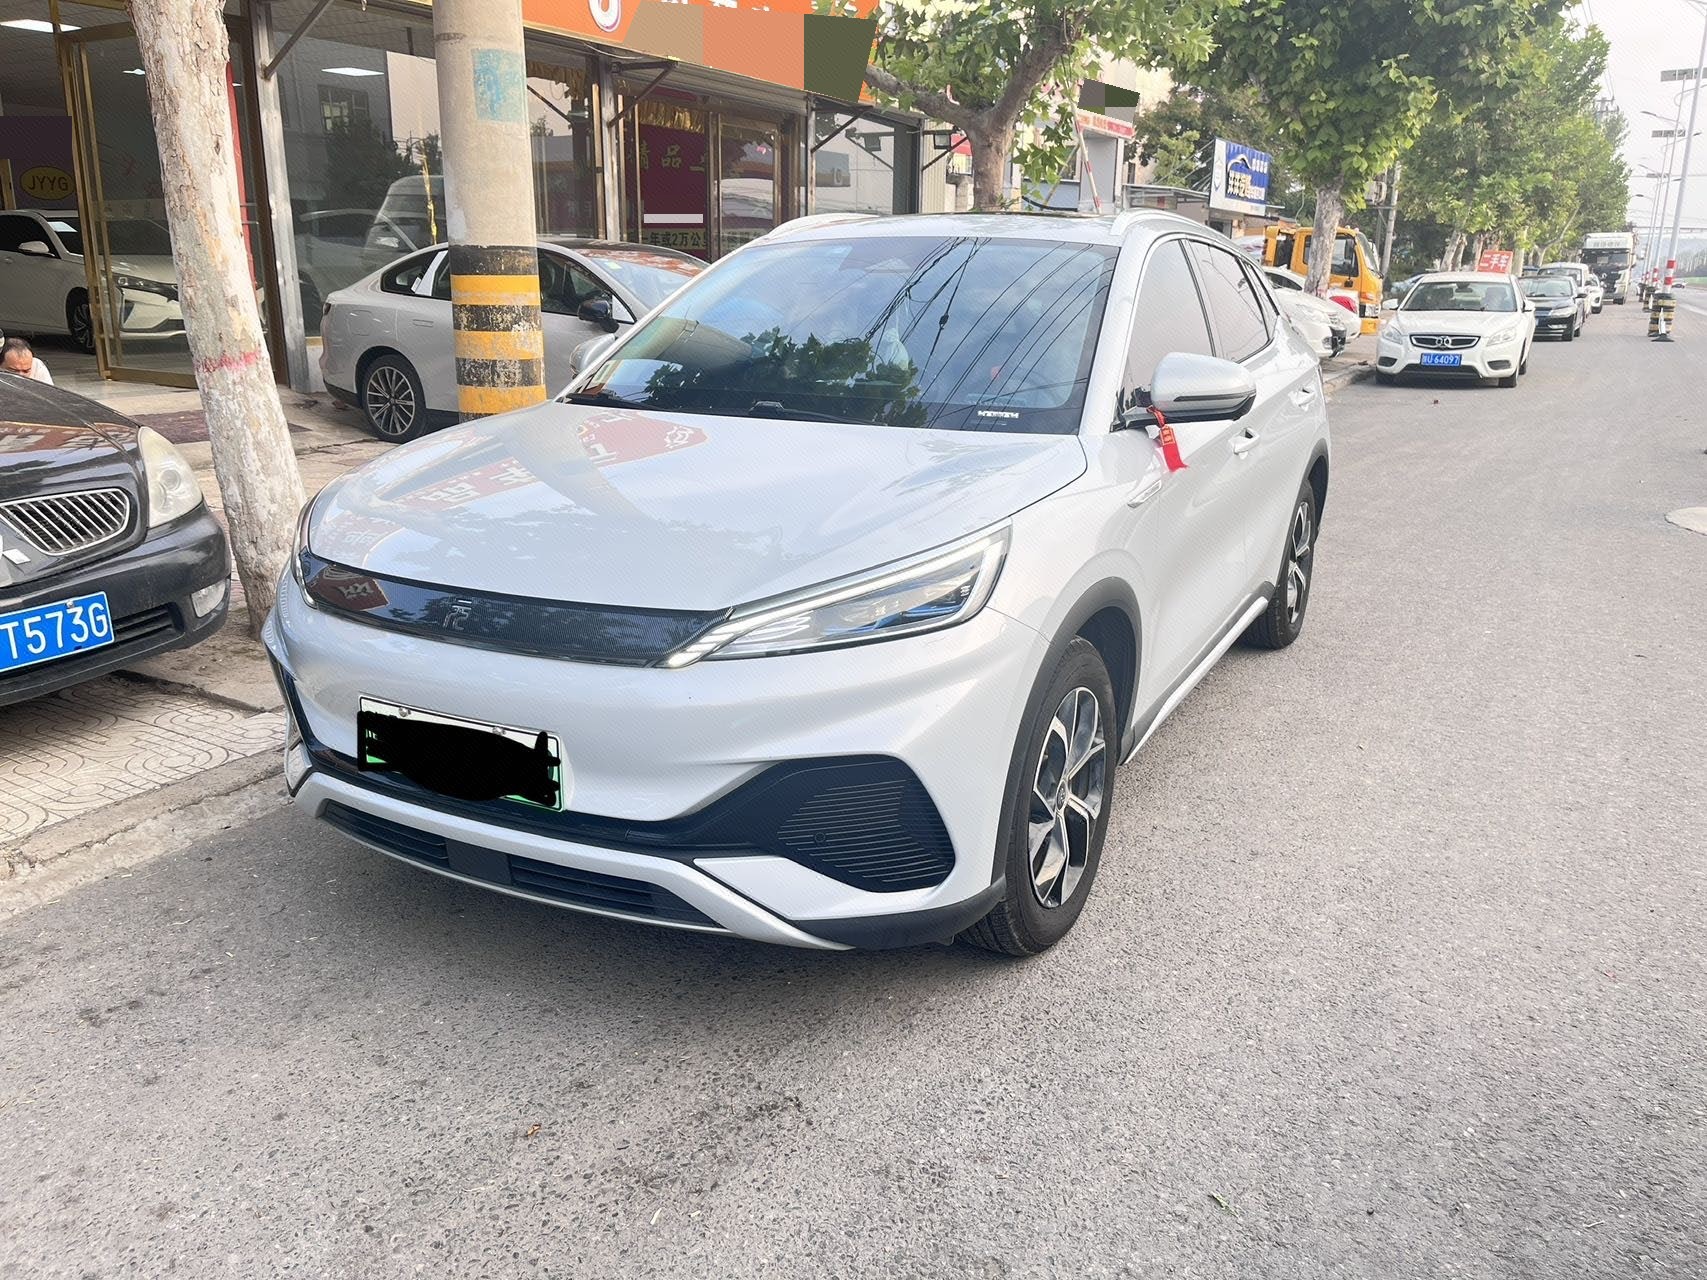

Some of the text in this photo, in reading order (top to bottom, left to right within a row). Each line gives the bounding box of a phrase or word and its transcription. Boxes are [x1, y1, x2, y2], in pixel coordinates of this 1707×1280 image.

[28, 175, 69, 191] JYYG
[1479, 253, 1510, 270] 二手车
[0, 603, 109, 660] T573G
